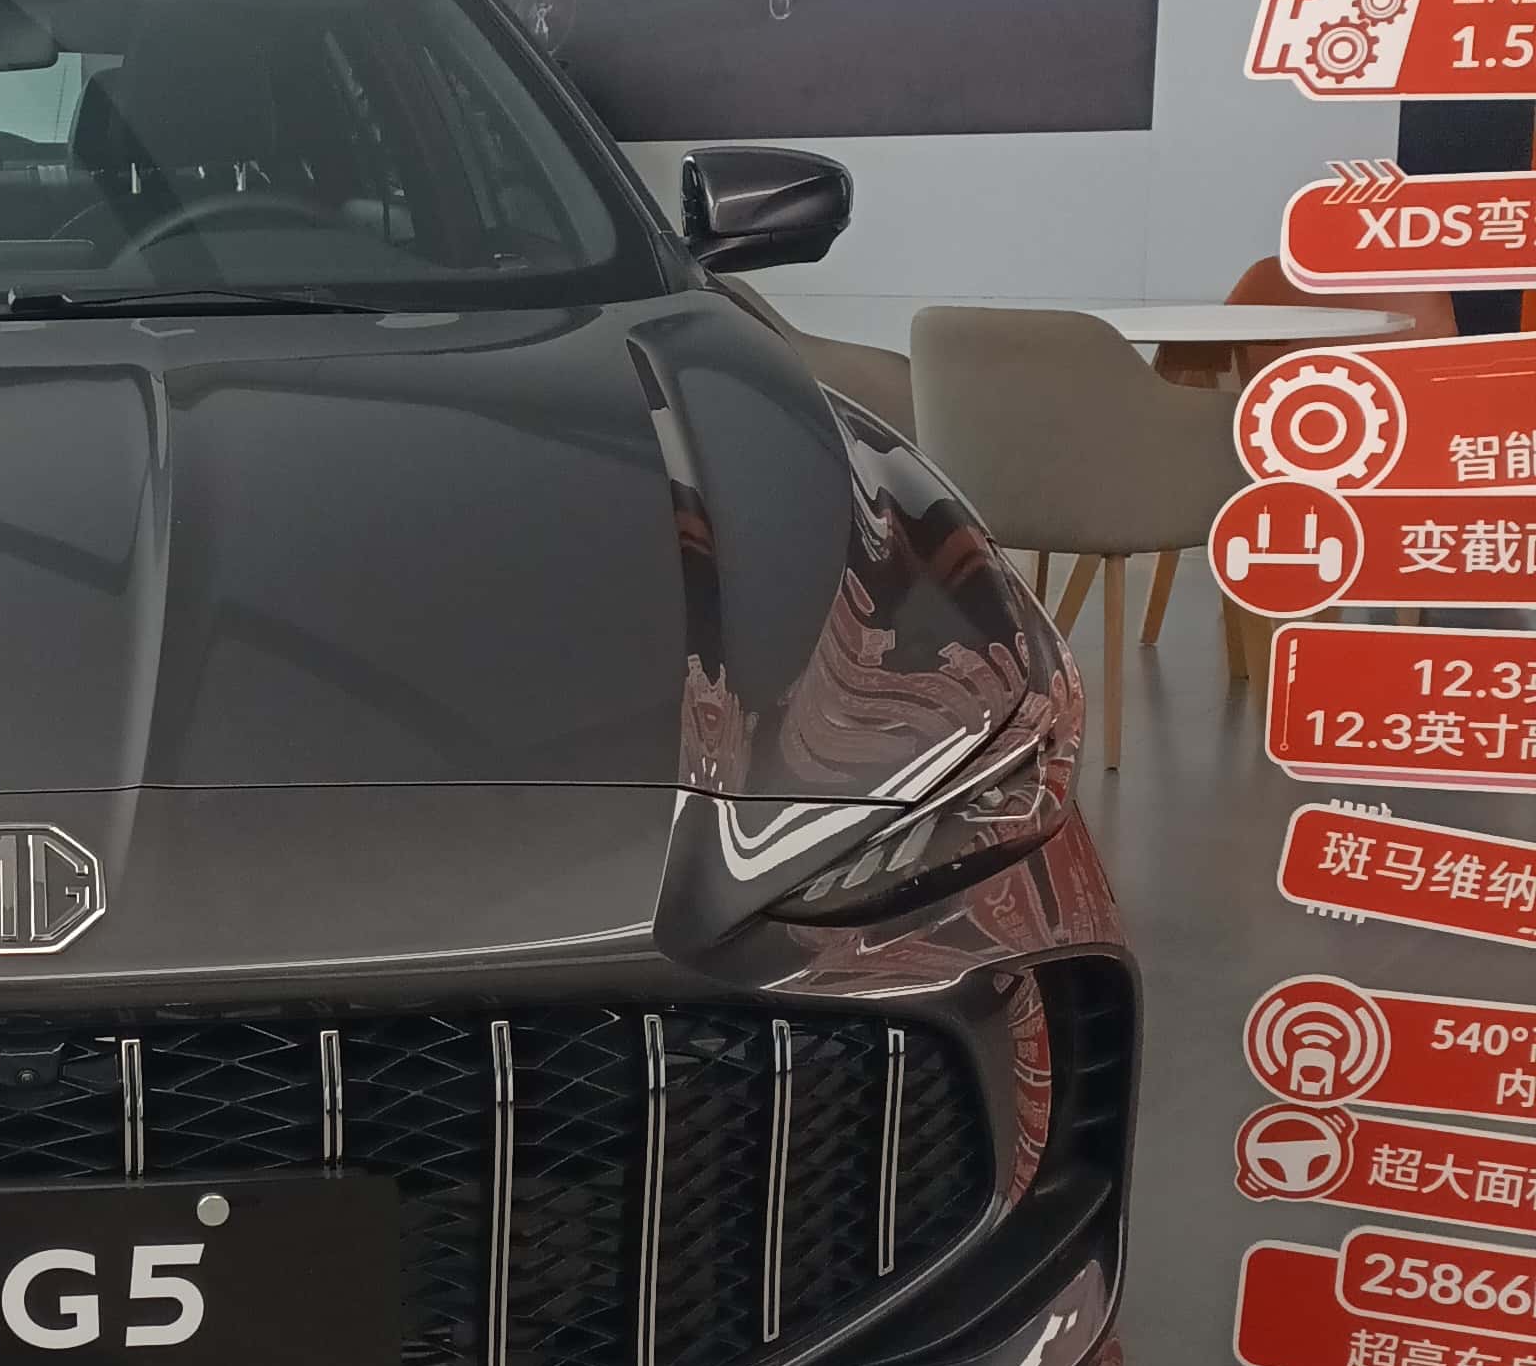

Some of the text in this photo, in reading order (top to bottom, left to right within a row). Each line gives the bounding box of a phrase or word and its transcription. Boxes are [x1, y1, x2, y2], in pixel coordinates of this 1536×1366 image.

[1452, 23, 1535, 69] 1.5
[1356, 197, 1536, 250] XDS弯
[1449, 431, 1536, 483] 智能
[1318, 830, 1536, 912] 斑马维纳
[1430, 1017, 1536, 1063] 540°
[1360, 1253, 1536, 1317] 25866
